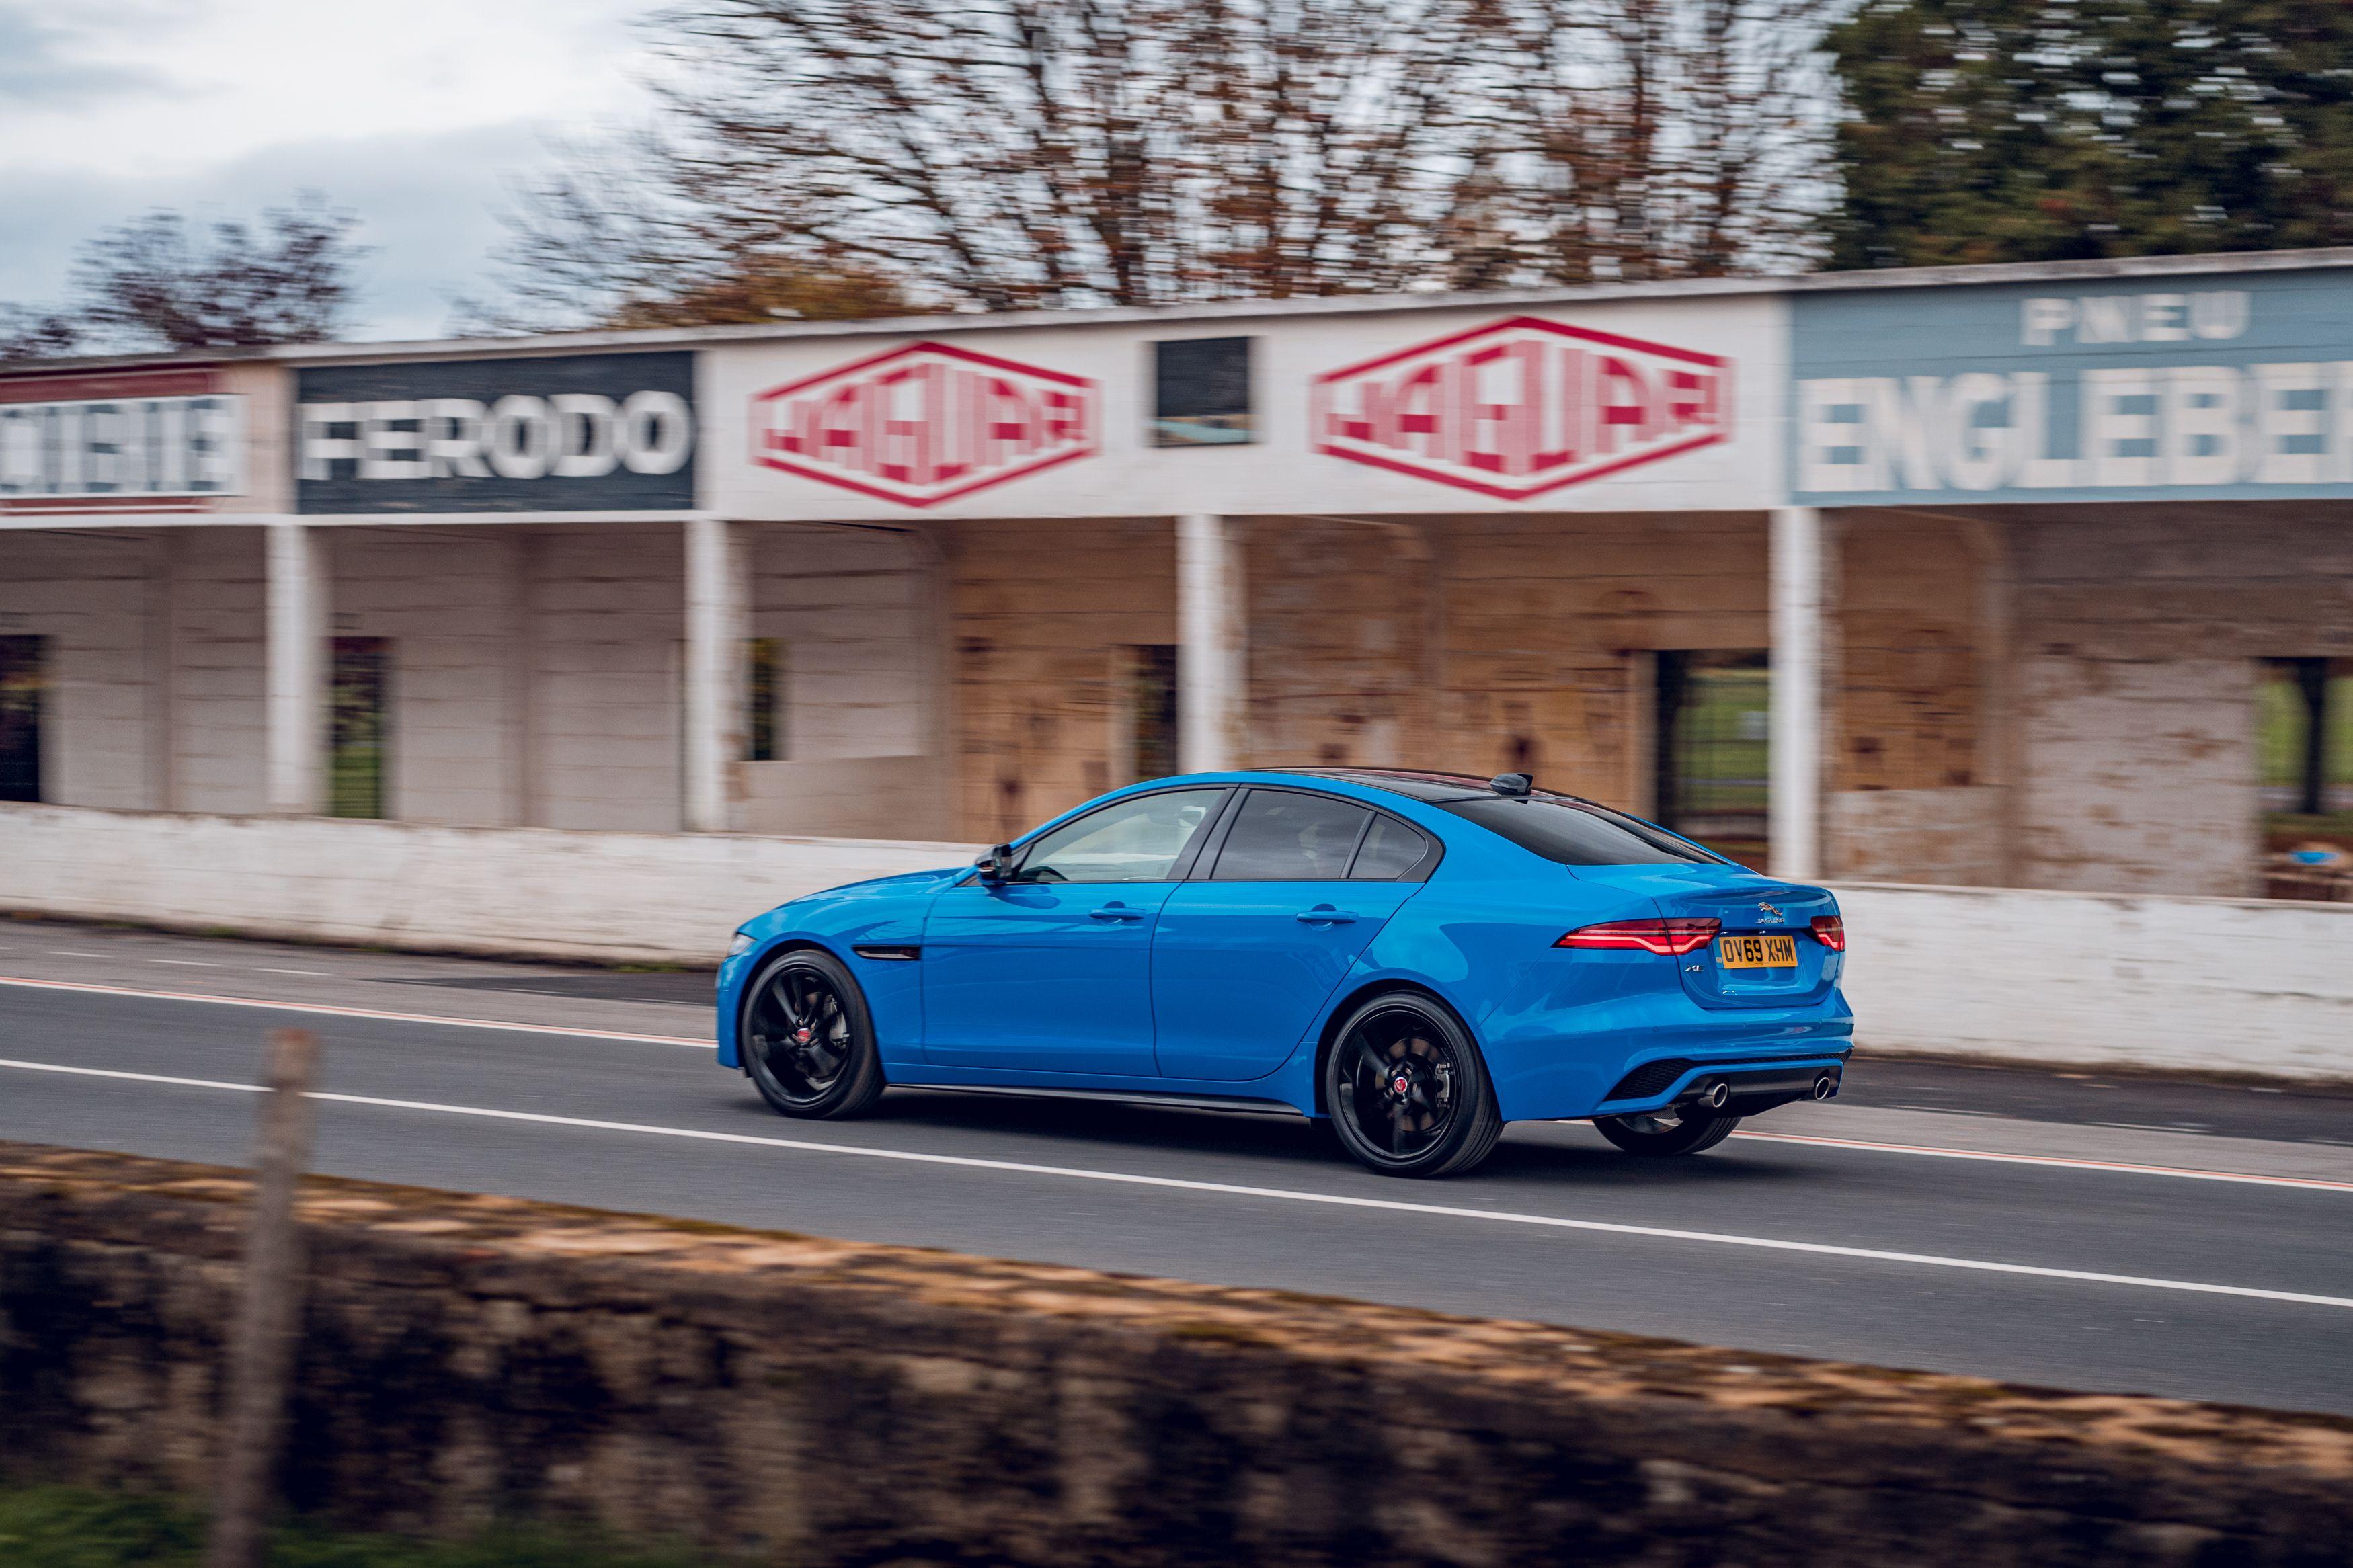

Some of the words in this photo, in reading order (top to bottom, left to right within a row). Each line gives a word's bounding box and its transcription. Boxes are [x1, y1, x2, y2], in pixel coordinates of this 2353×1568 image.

[2021, 291, 2250, 345] PNEU
[300, 390, 693, 479] FERODO
[760, 363, 1089, 485] JAGUAR
[1324, 339, 1719, 477] JAGUAR
[1723, 939, 1763, 962] OV69
[1765, 939, 1794, 962] XHM
